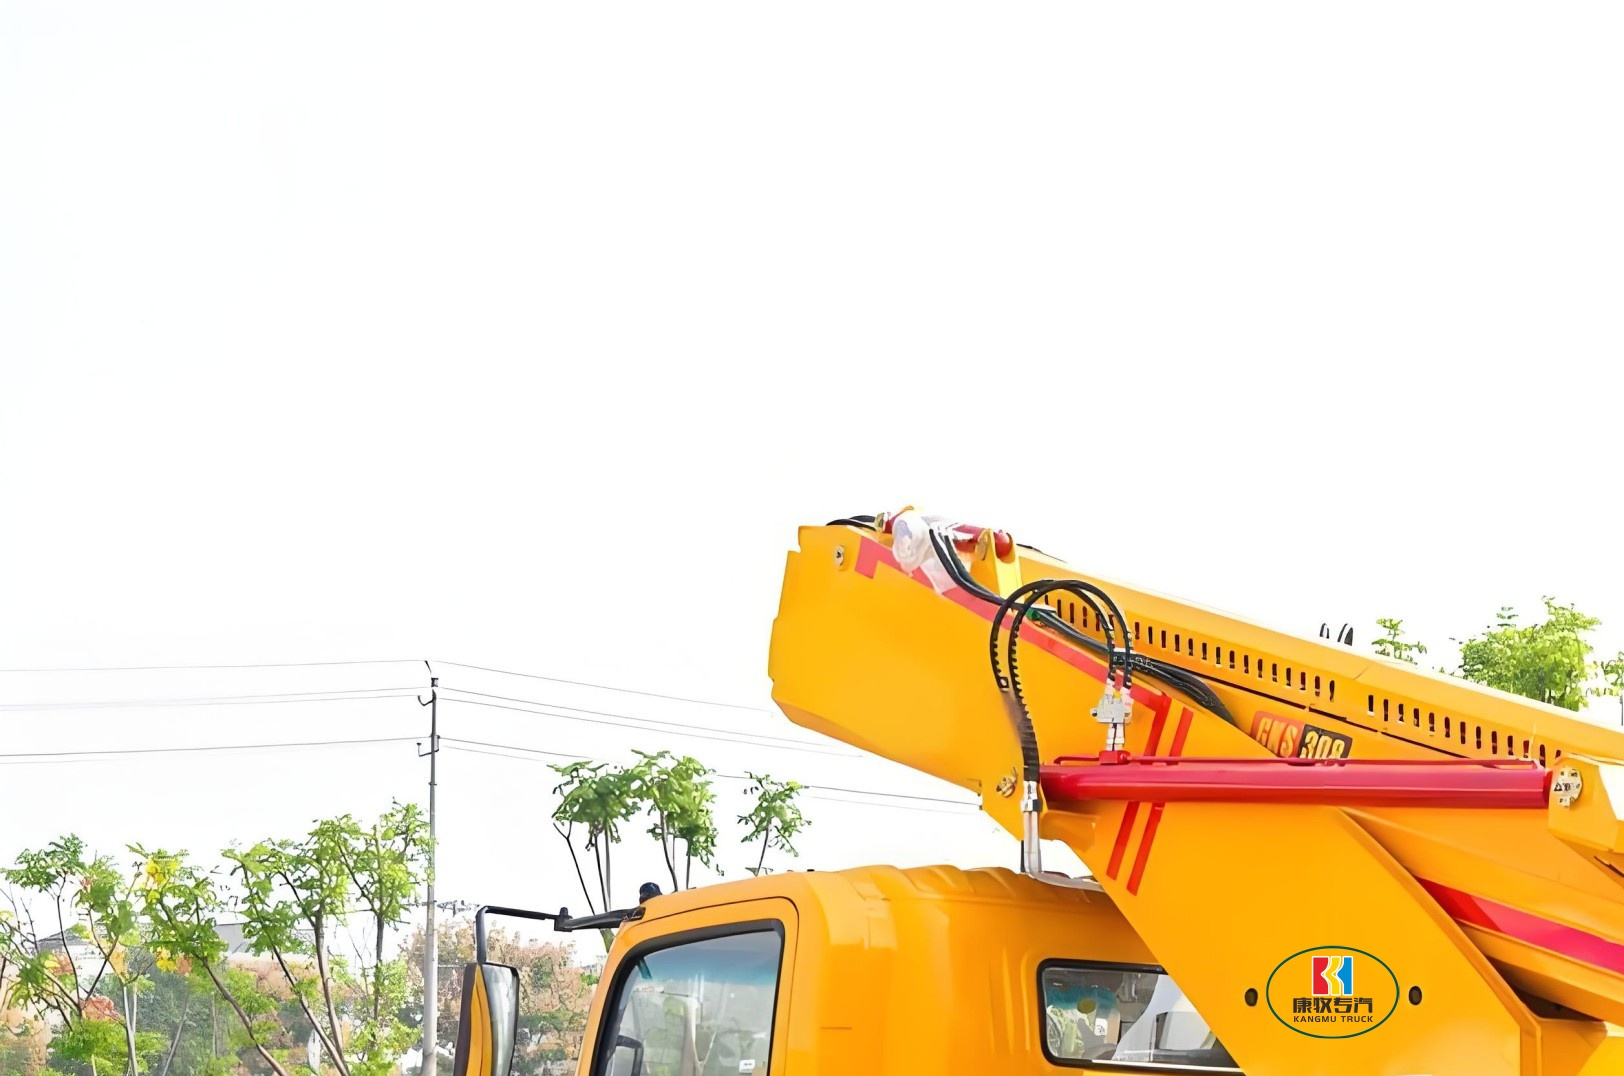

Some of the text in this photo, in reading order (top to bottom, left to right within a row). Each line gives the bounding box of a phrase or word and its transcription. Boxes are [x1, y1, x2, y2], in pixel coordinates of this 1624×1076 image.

[1293, 997, 1373, 1013] 康牧专汽
[1293, 1015, 1373, 1023] KANGMU TRUCK
